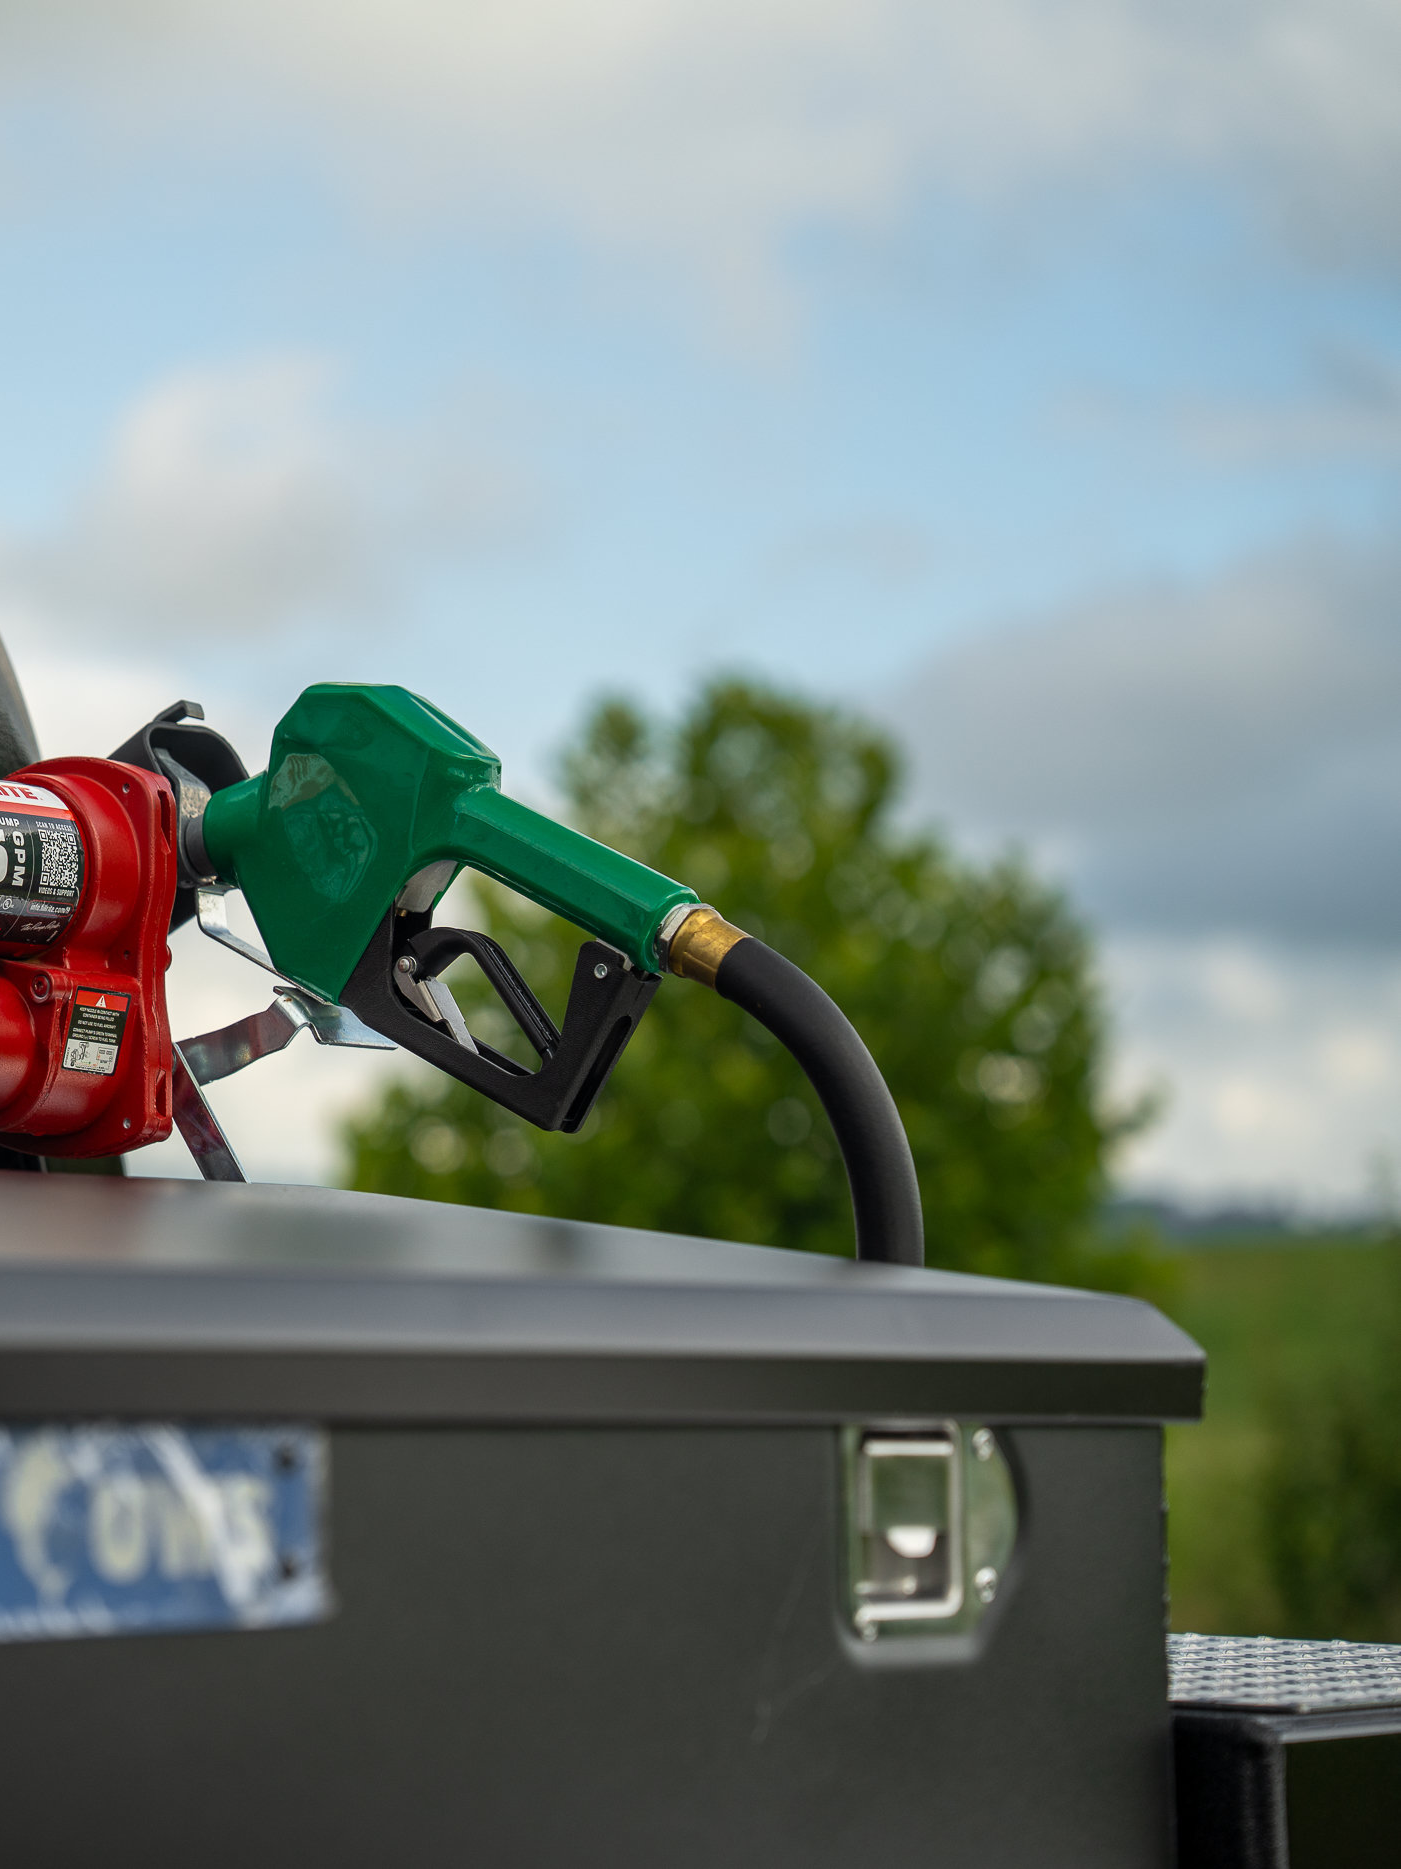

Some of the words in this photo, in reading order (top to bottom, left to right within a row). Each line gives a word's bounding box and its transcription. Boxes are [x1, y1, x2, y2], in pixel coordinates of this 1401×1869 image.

[11, 831, 26, 887] GPM
[38, 886, 53, 895] VIDEOS
[56, 888, 75, 897] SUPPORT
